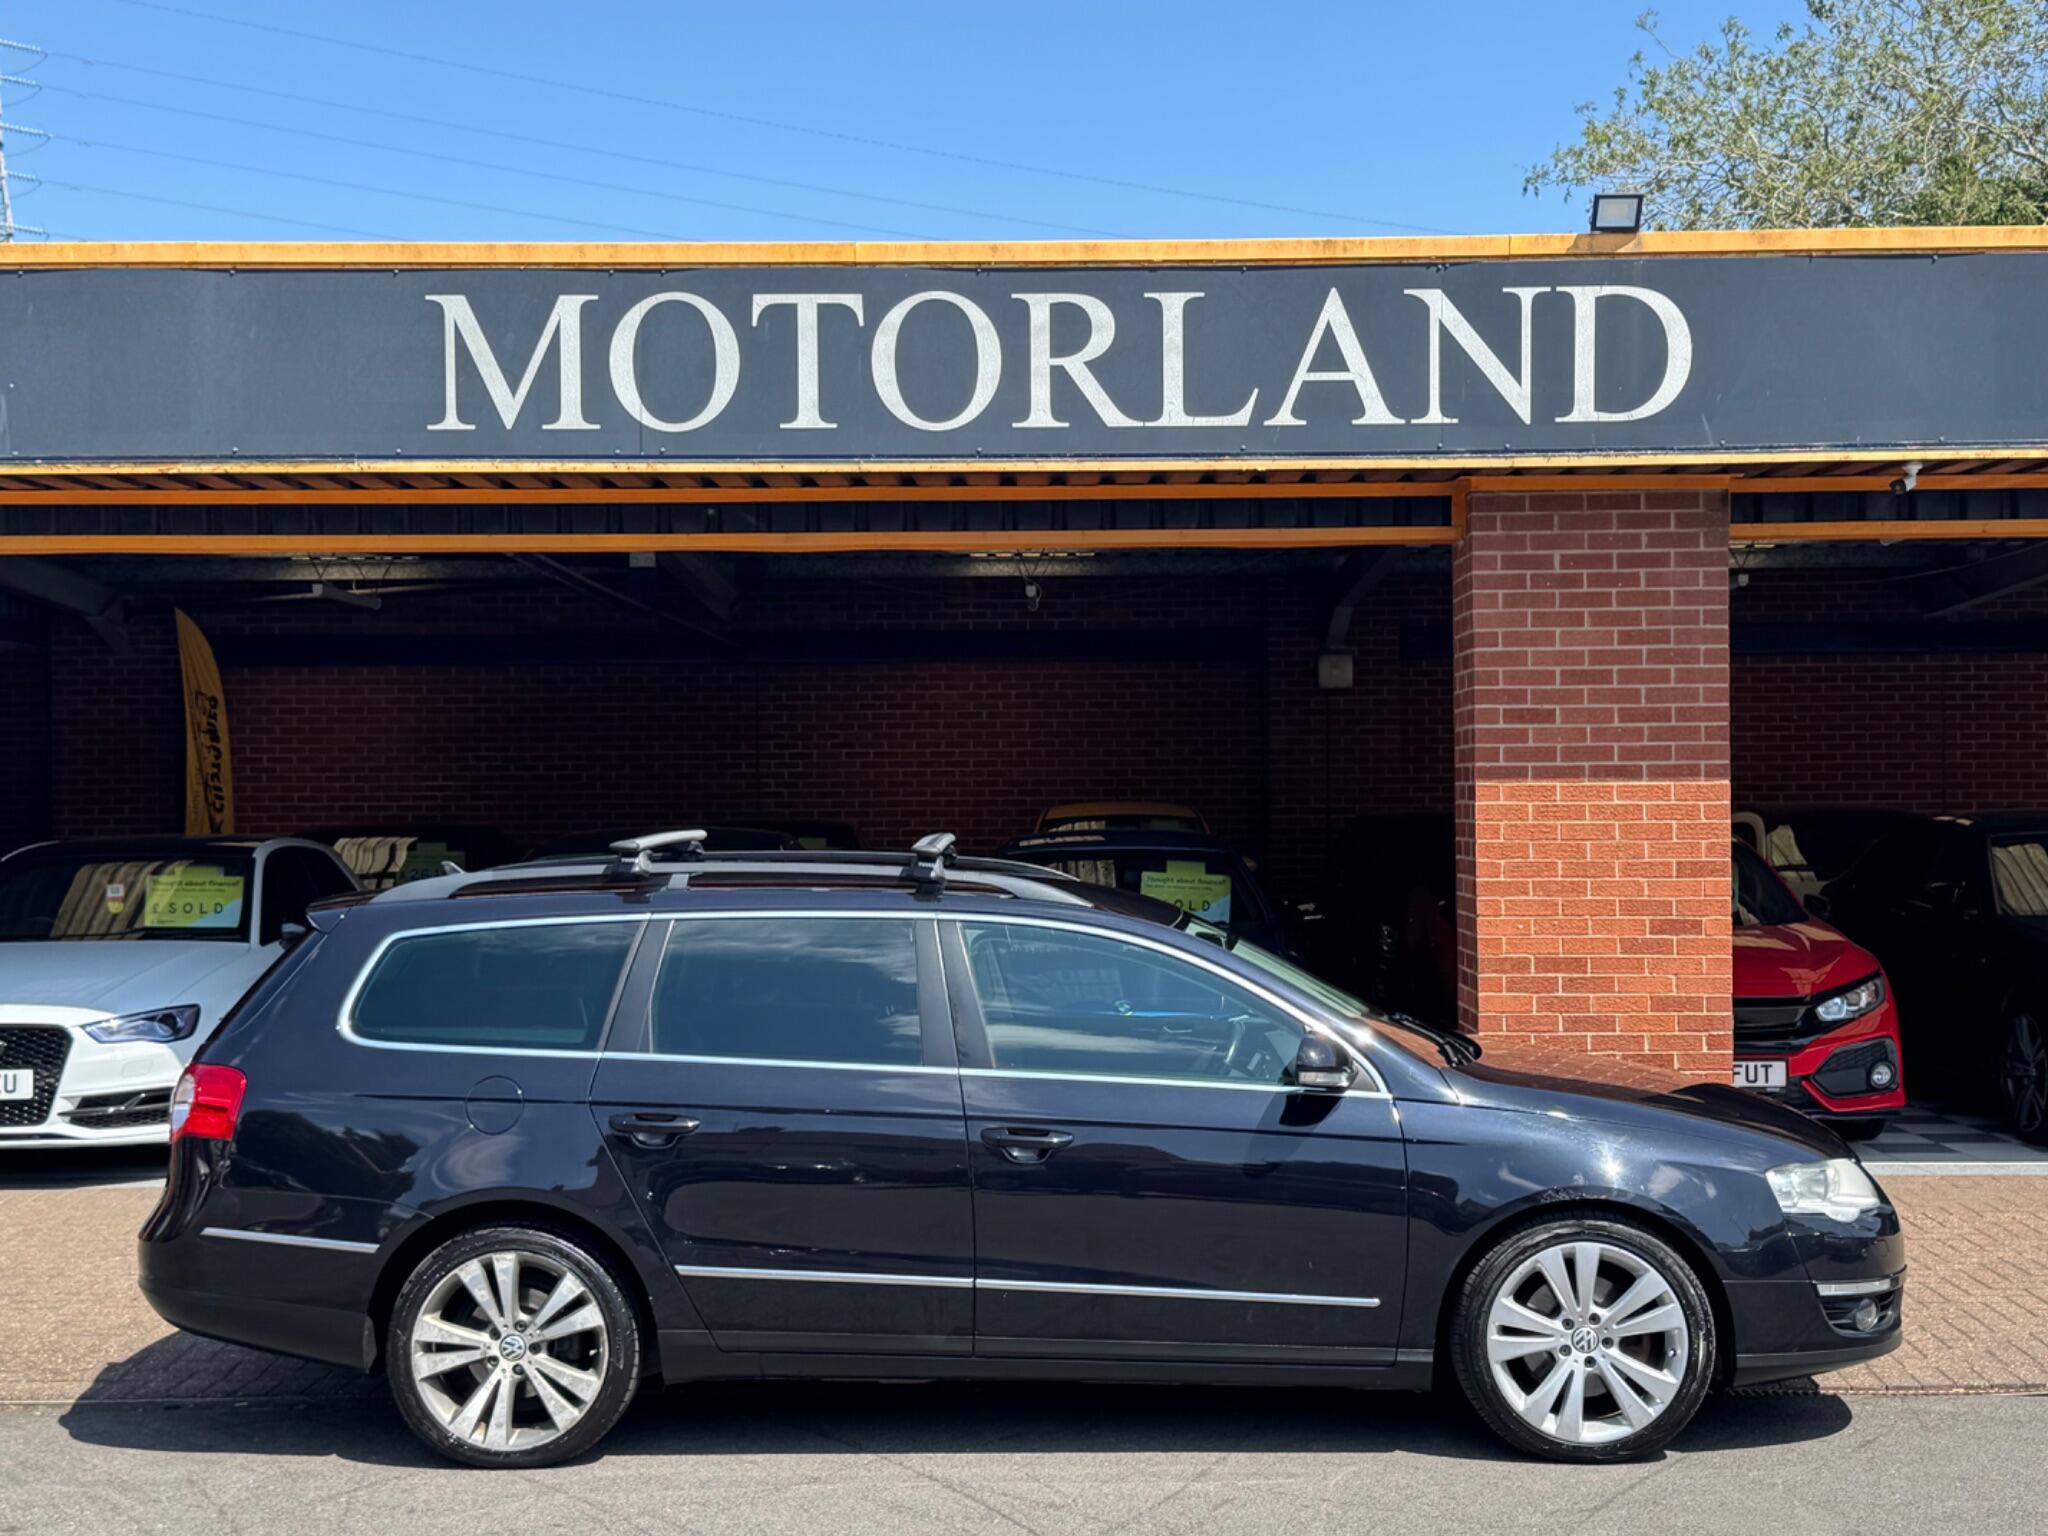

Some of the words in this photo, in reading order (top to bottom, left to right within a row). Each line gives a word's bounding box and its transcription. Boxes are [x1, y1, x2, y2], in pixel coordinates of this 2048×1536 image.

[425, 285, 1692, 432] MOTORLAND
[168, 902, 223, 914] SOLD
[1174, 899, 1210, 911] OLD
[0, 1073, 17, 1094] U
